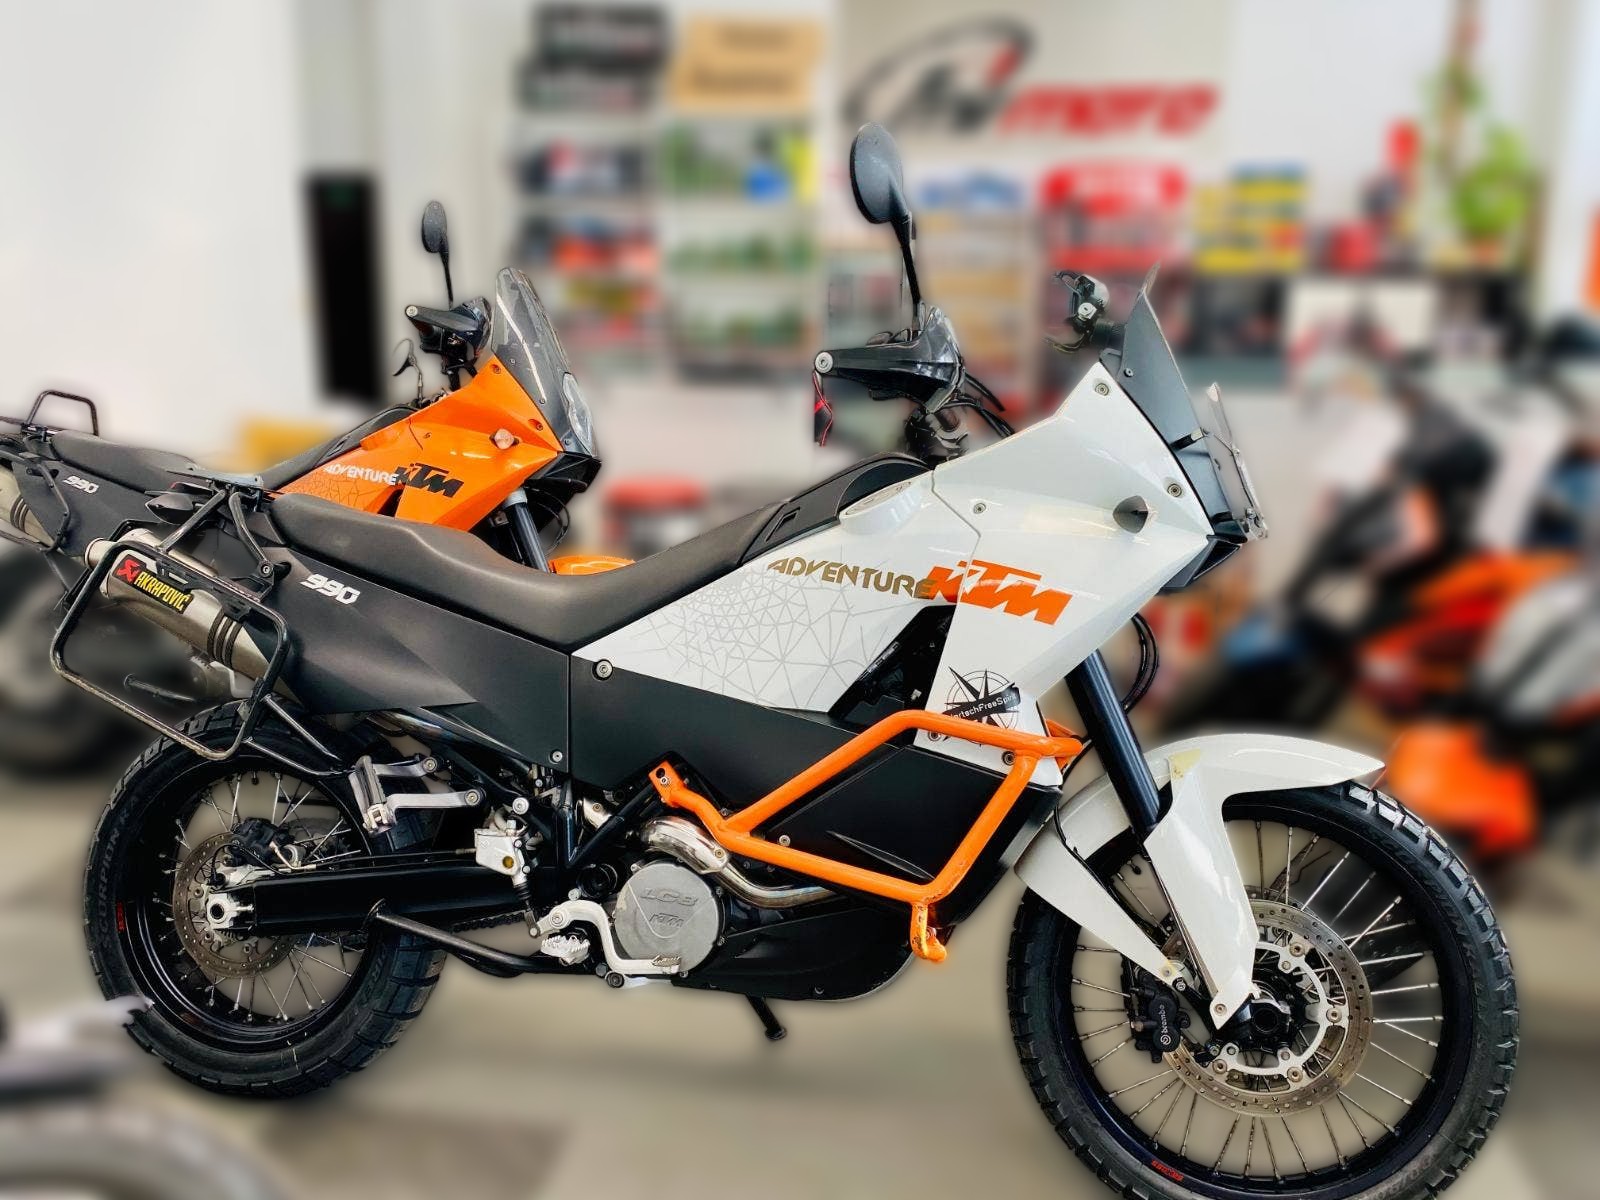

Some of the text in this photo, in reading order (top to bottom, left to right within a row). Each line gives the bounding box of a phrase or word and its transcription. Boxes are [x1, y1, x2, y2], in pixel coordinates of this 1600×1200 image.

[62, 475, 100, 494] 990
[322, 462, 464, 498] ADVENTURE KTM
[299, 573, 361, 605] 990
[767, 556, 1073, 626] ADVENTURE KTM
[1158, 1003, 1169, 1034] brembo
